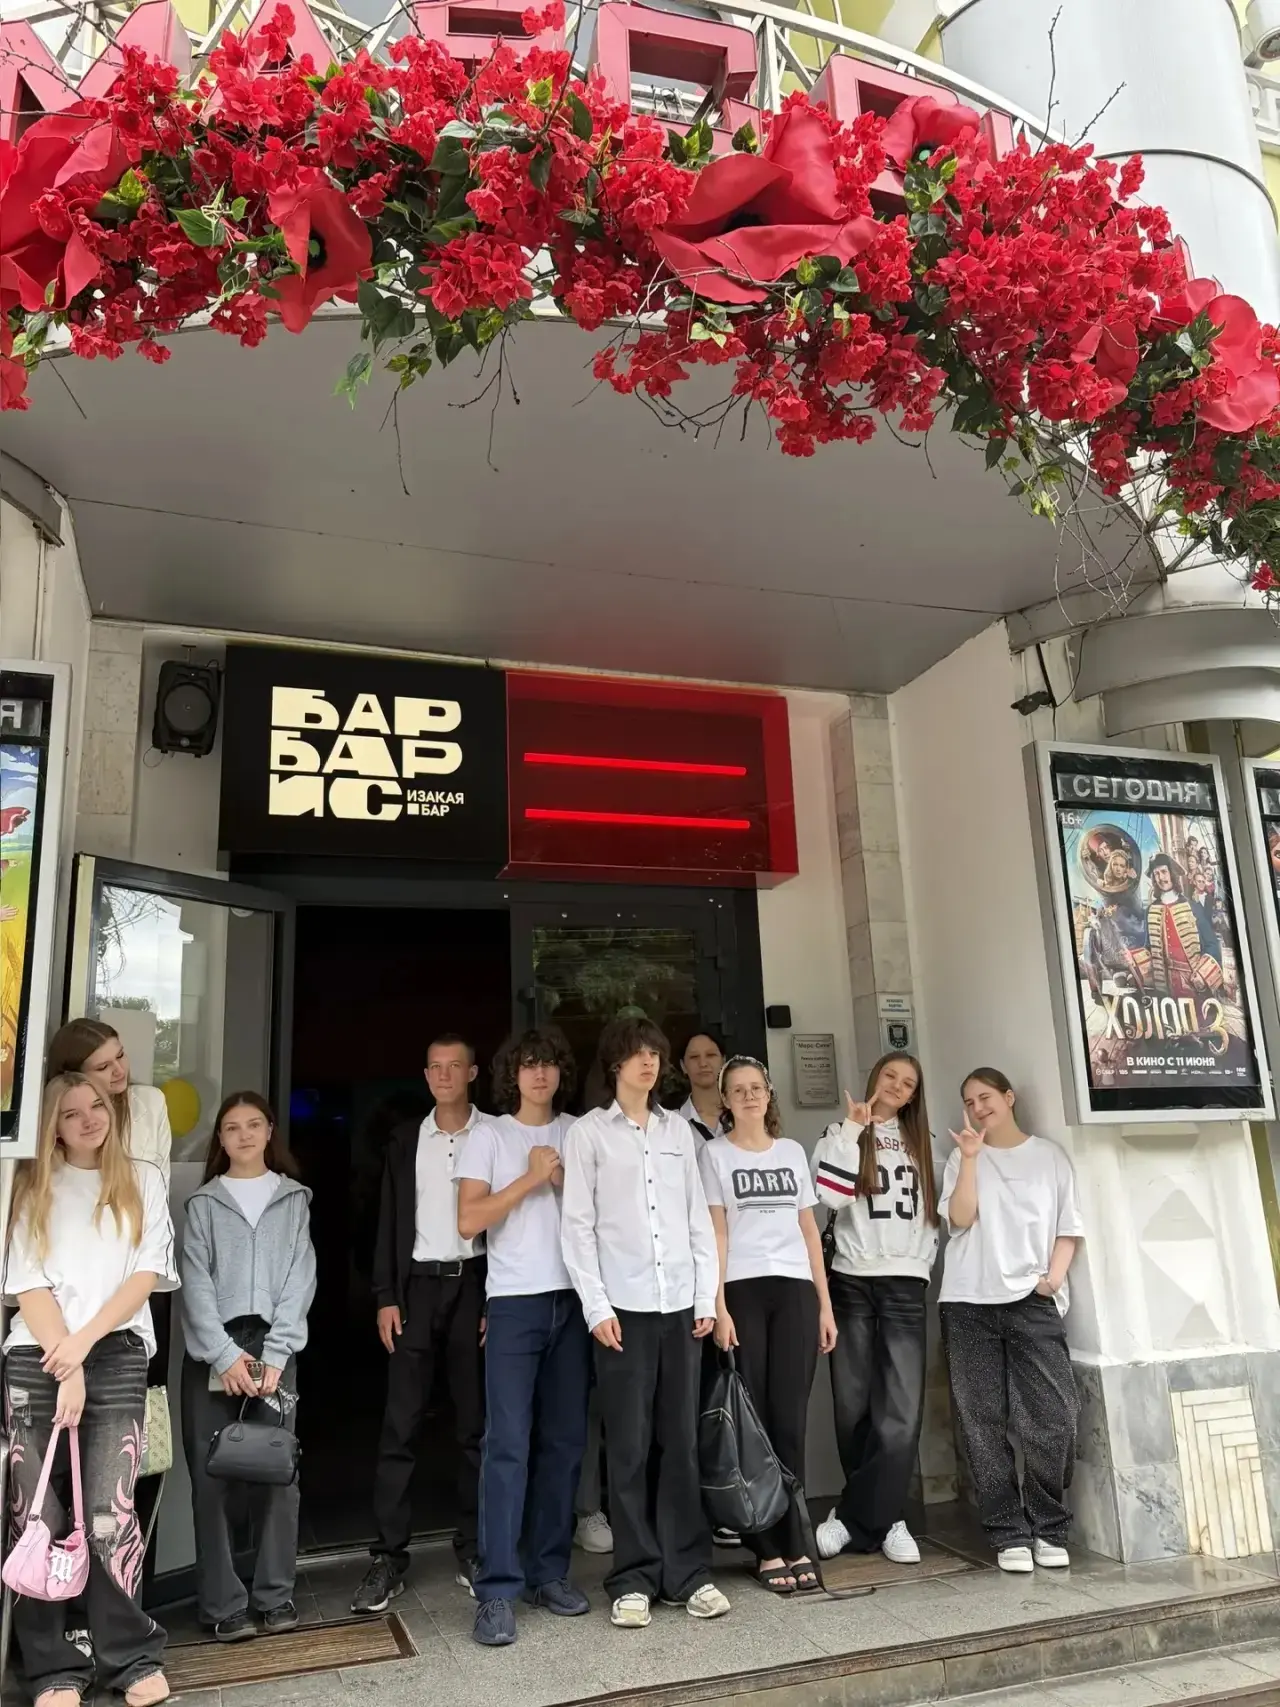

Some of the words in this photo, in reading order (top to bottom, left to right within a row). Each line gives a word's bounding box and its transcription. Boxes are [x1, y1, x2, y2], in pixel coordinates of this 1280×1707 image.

[271, 686, 462, 737] БАР
[270, 729, 463, 779] БАР
[268, 773, 403, 821] ИС
[407, 789, 465, 804] ИЗАКАЯ
[1072, 774, 1201, 805] СЕГОДНЯ
[421, 803, 450, 817] БАР
[1060, 812, 1082, 825] 16+
[1101, 994, 1200, 1040] ХОЛОП
[1201, 997, 1230, 1056] 3
[1126, 1057, 1134, 1066] В
[1136, 1057, 1166, 1067] КИНО
[1167, 1057, 1175, 1066] С
[1177, 1057, 1184, 1066] 11
[1186, 1057, 1216, 1067] ИЮНЯ
[736, 1170, 796, 1194] DARK
[866, 1164, 919, 1220] 23
